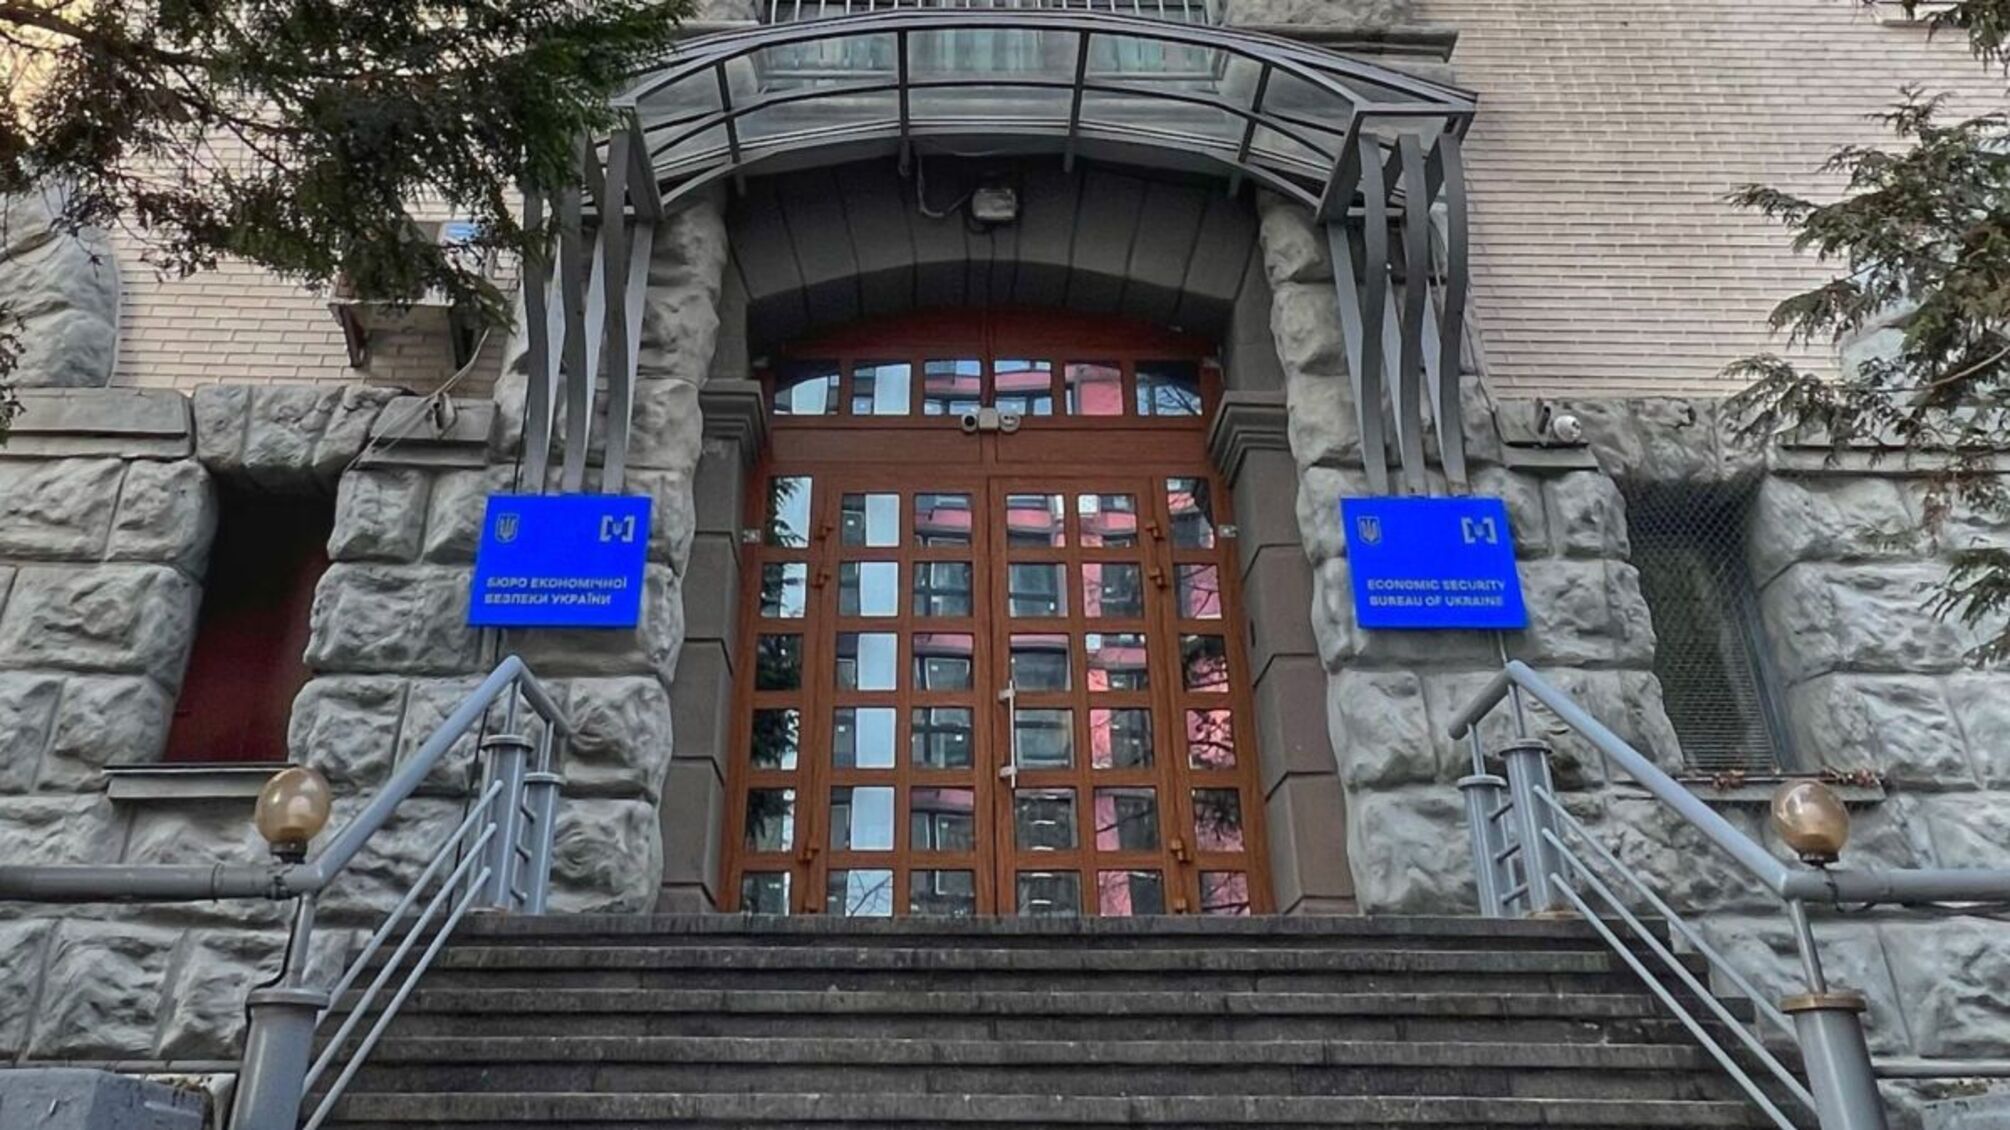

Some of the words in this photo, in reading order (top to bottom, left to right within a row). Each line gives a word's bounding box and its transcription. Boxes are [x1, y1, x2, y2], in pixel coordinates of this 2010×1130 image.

[486, 576, 526, 589] БЮРО
[530, 576, 627, 589] ЕКОНОМІЧНОЇ
[1367, 579, 1438, 591] ECONOMIC
[1443, 579, 1505, 591] SECURITY
[484, 594, 547, 605] БЕЗПЕКИ
[552, 593, 611, 605] УКРАЇНИ
[1369, 595, 1423, 607] BUREAU
[1426, 595, 1442, 607] OF
[1445, 595, 1504, 607] UKRAINE
